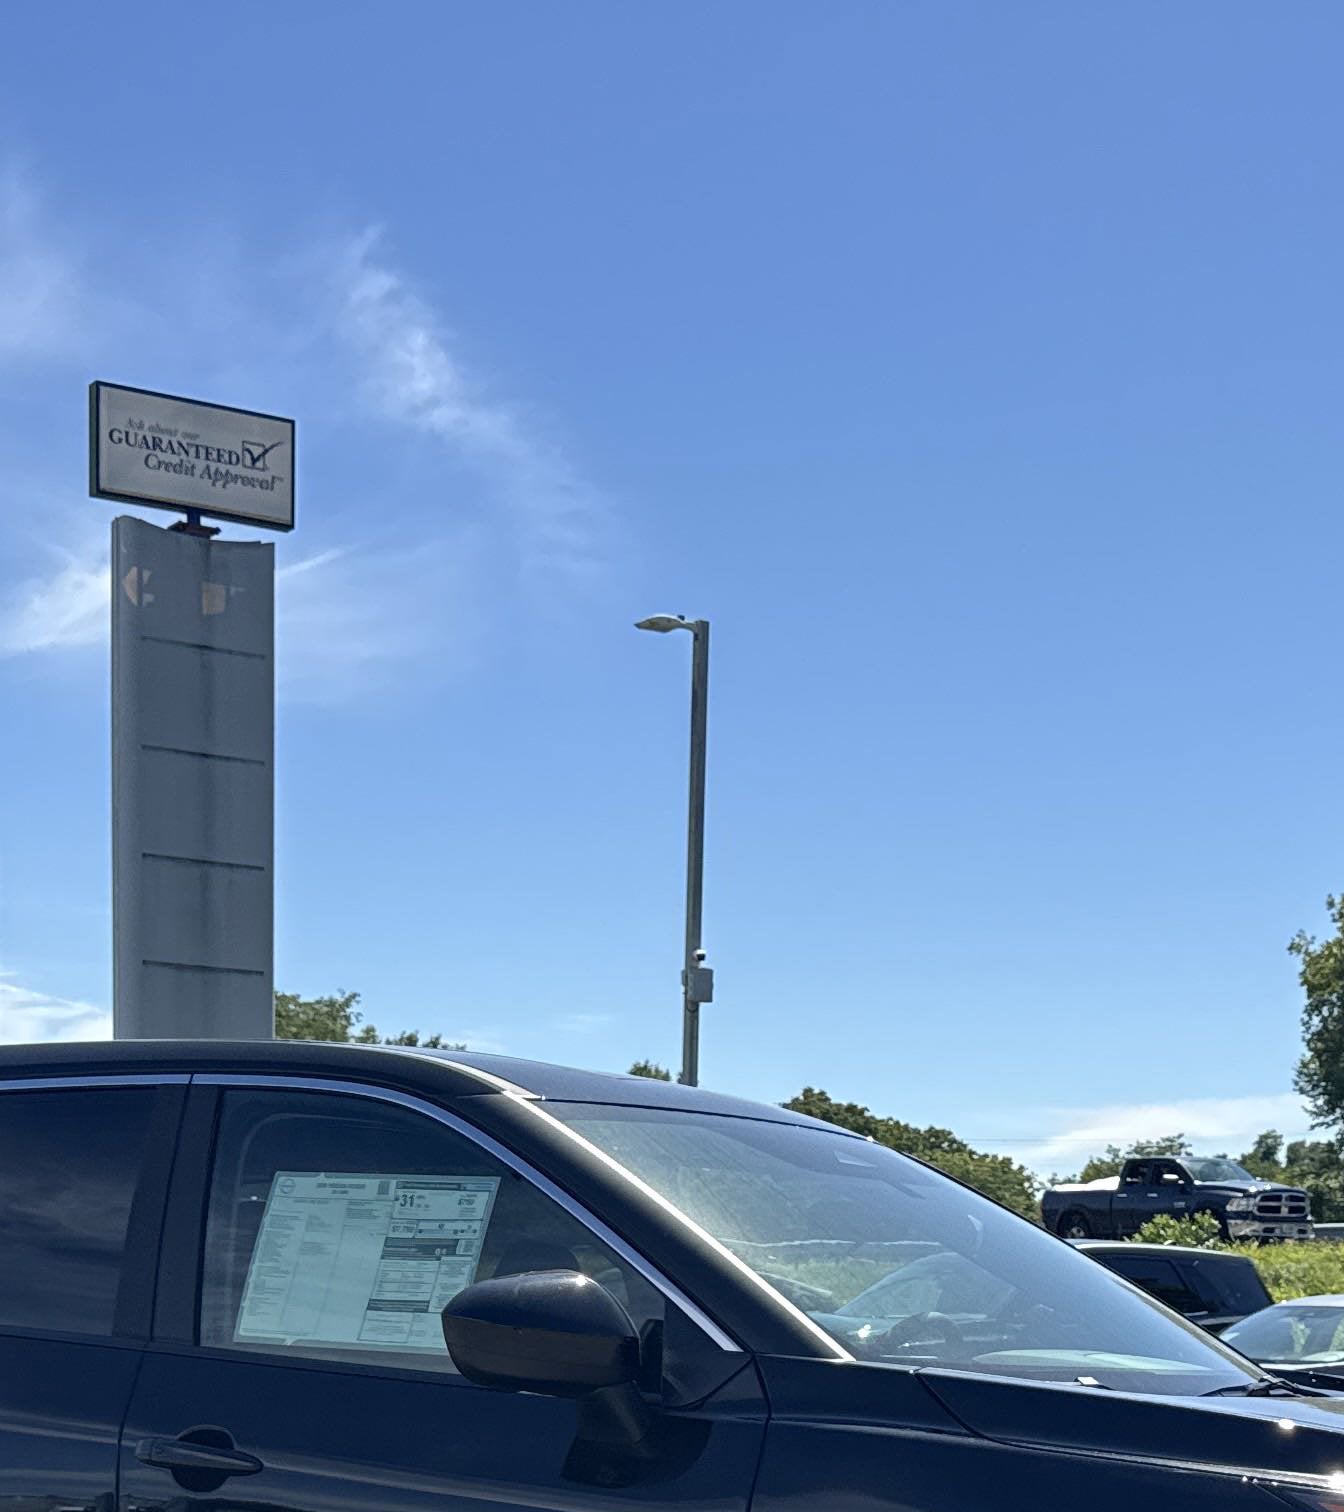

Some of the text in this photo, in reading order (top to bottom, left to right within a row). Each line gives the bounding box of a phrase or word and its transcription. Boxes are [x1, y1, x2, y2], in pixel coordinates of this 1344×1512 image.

[148, 422, 179, 437] about
[109, 428, 240, 466] GUARANTEED
[144, 453, 275, 491] Credit Approval
[399, 1193, 415, 1208] 31
